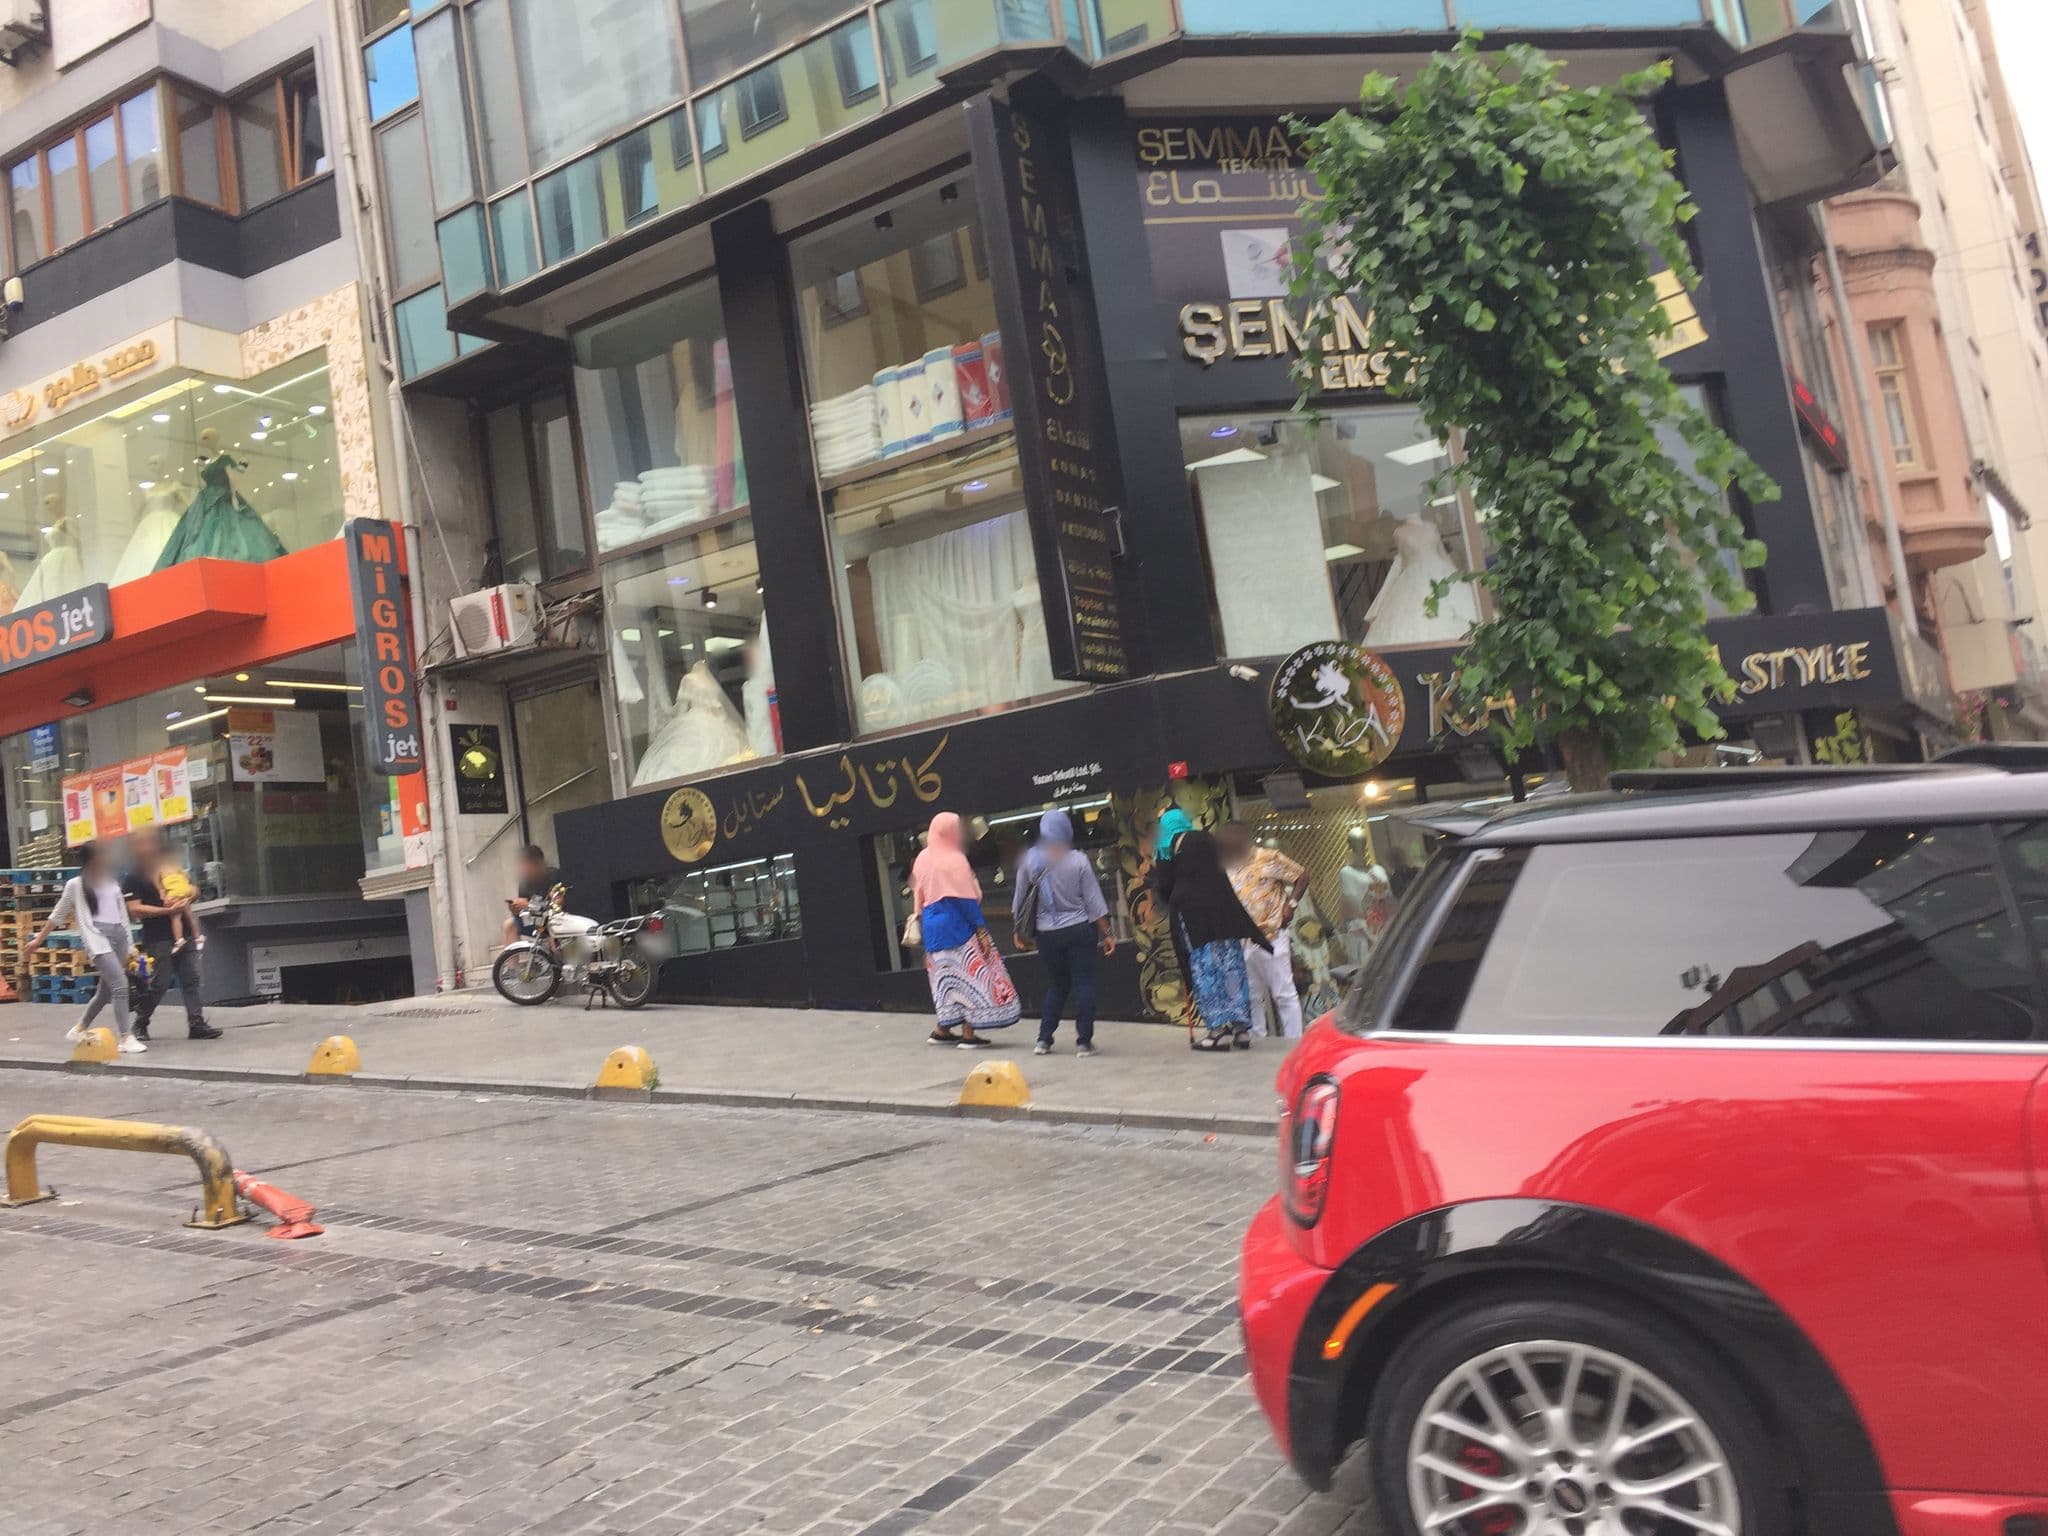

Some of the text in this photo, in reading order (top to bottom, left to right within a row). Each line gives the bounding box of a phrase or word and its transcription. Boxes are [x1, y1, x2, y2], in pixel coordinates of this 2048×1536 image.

[1137, 126, 1314, 166] ŞEMMA
[59, 596, 95, 645] jet
[1740, 641, 1872, 694] STYLE
[384, 733, 419, 763] jet
